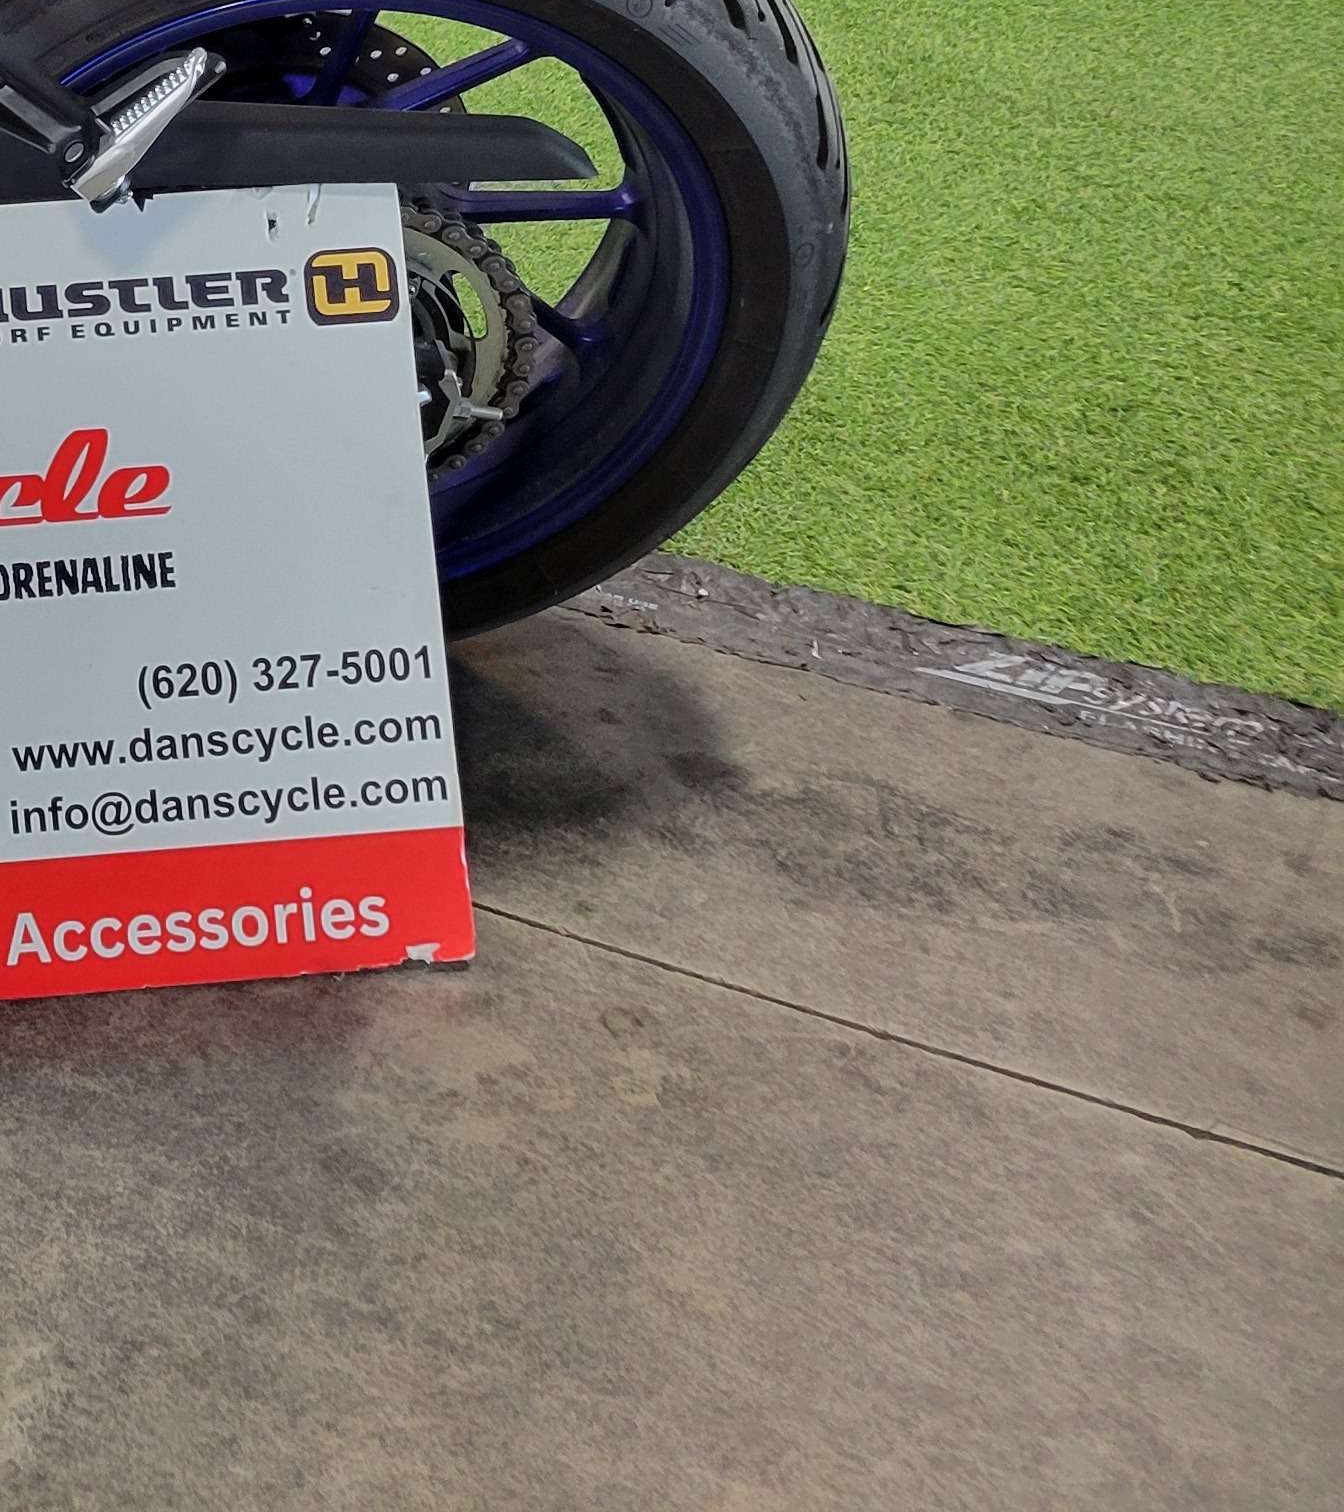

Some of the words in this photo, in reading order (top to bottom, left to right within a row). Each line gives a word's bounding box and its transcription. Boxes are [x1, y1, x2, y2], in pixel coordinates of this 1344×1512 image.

[70, 309, 293, 341] EQUIPMENT
[137, 658, 238, 710] (620)
[251, 644, 433, 692] 327-5001
[11, 713, 442, 772] www.danscycle.com
[9, 775, 449, 836] info@danscycle.com
[6, 886, 391, 967] Accessories
